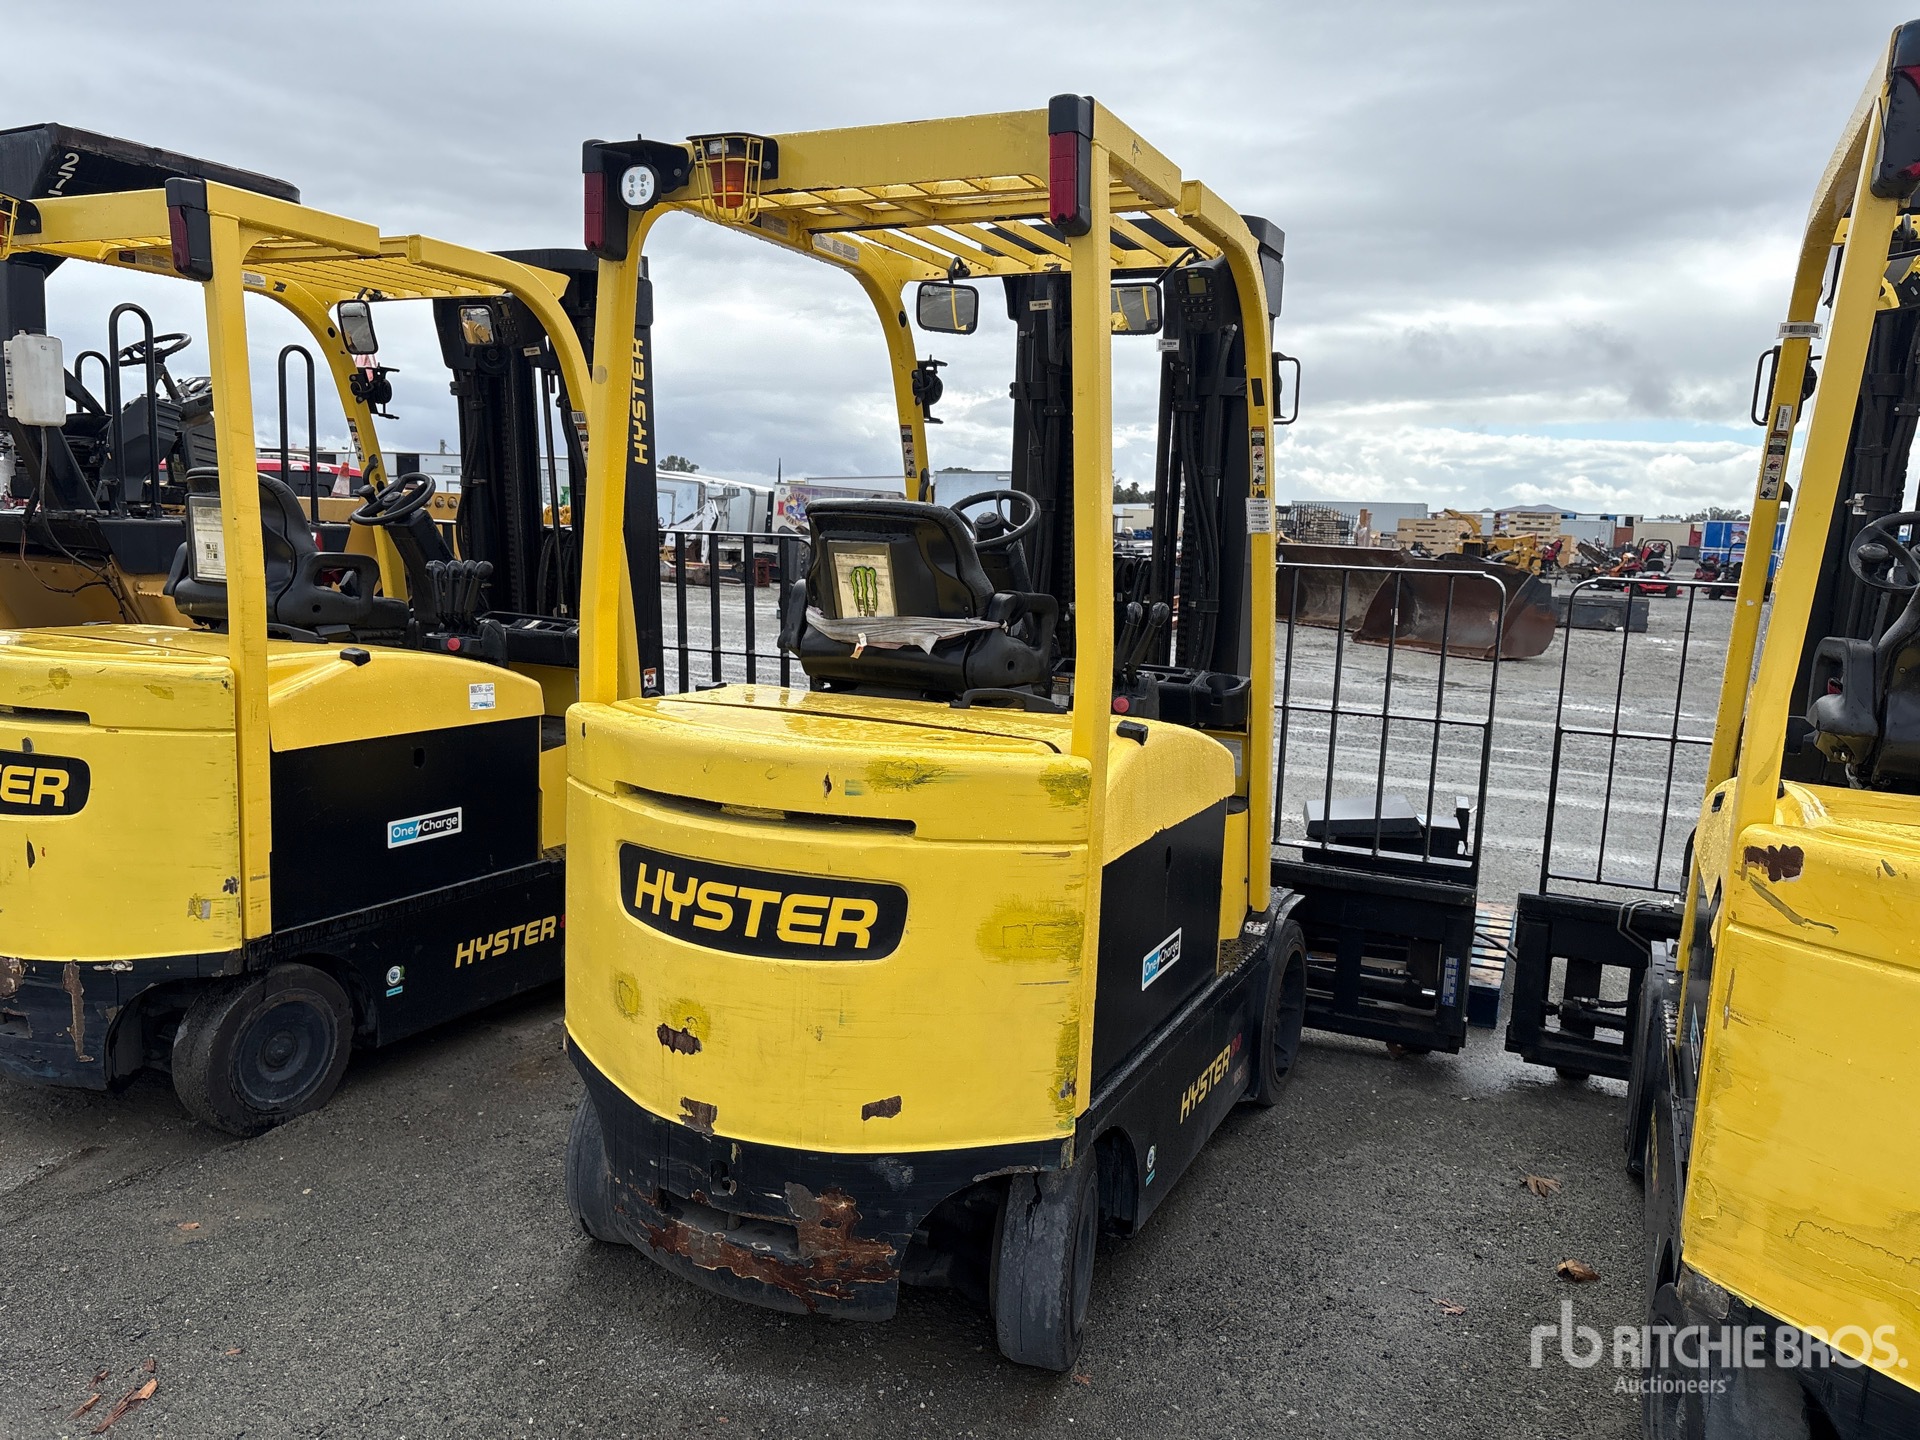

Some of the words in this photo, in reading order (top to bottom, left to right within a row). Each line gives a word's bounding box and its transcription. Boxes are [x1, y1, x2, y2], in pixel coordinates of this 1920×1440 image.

[632, 339, 649, 465] HYSTER
[0, 763, 70, 807] ER
[392, 826, 414, 838] One
[421, 816, 458, 830] Charge
[634, 862, 879, 949] HYSTER
[454, 915, 557, 968] HYSTER
[1180, 1044, 1231, 1125] HYSTER
